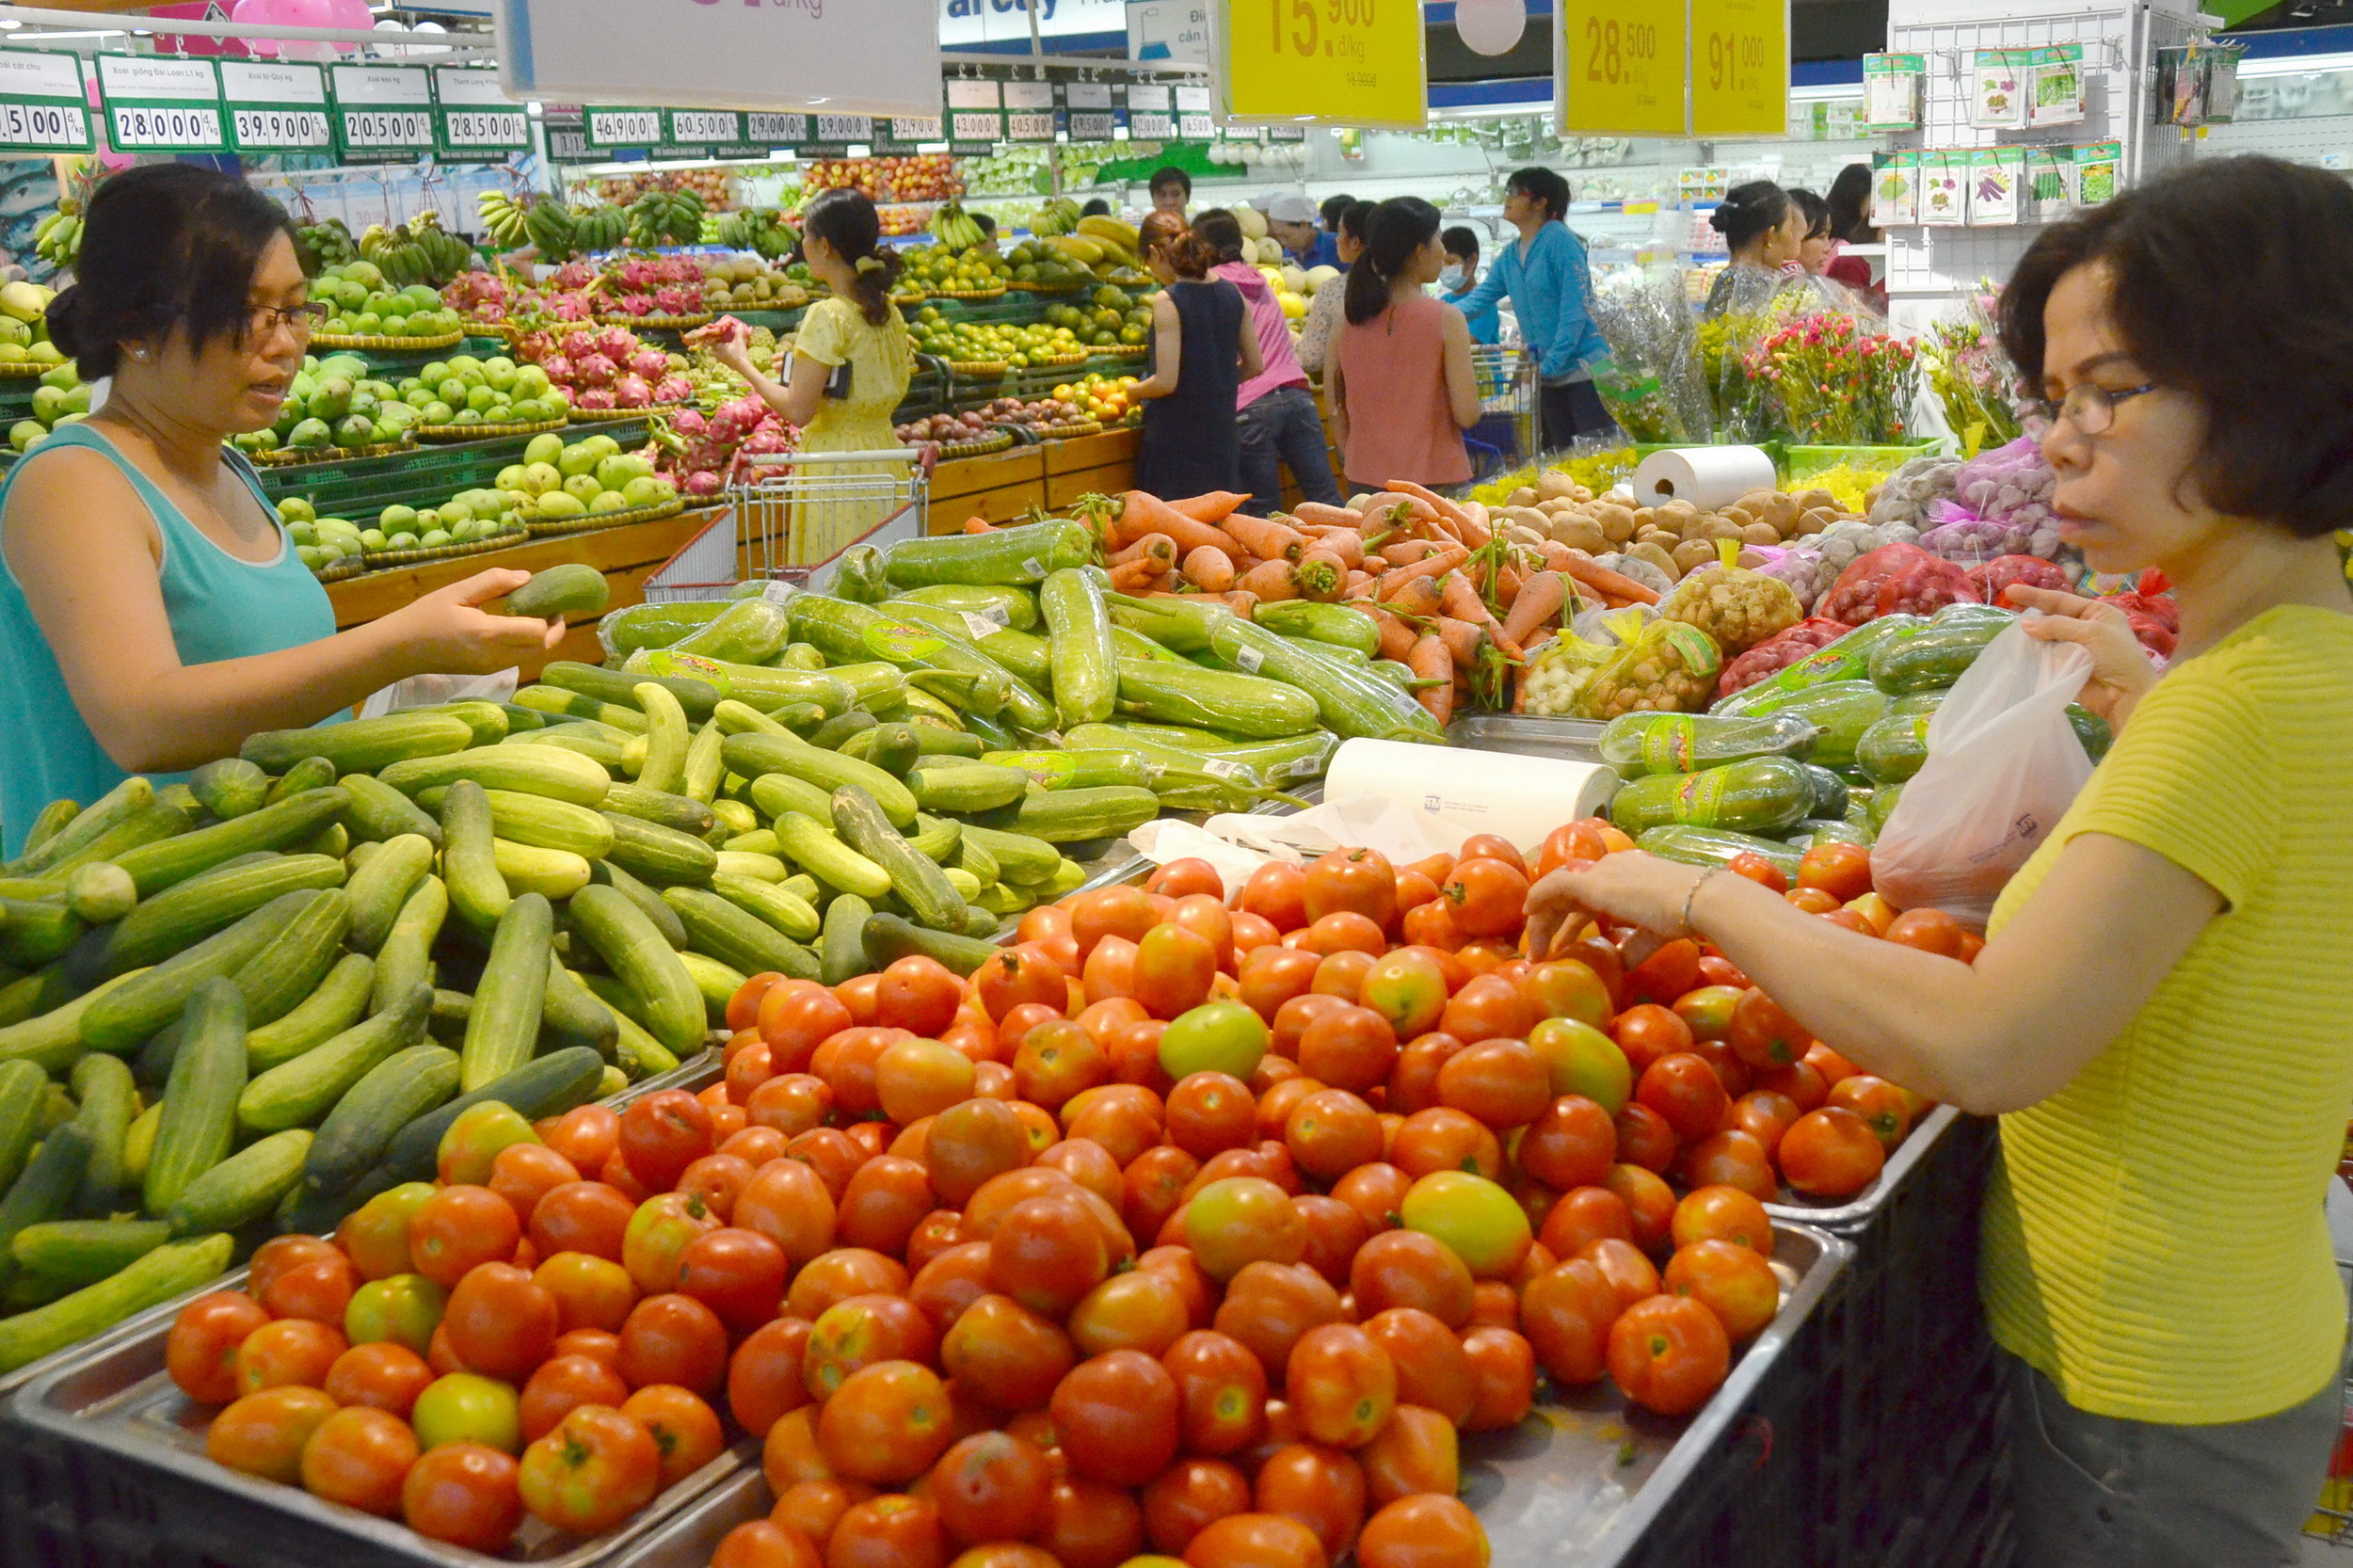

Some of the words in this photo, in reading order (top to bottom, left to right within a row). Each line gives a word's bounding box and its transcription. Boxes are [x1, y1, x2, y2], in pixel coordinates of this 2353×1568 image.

[0, 110, 60, 136] .500
[120, 113, 200, 136] 28.000
[239, 115, 310, 138] 39.900
[347, 116, 415, 137] 20.500
[452, 117, 511, 136] 28.500
[596, 117, 647, 136] 46.900
[677, 116, 726, 135] 60.500
[750, 117, 795, 135] 29.000
[819, 117, 861, 134] 39.000
[893, 118, 933, 134] 52.900
